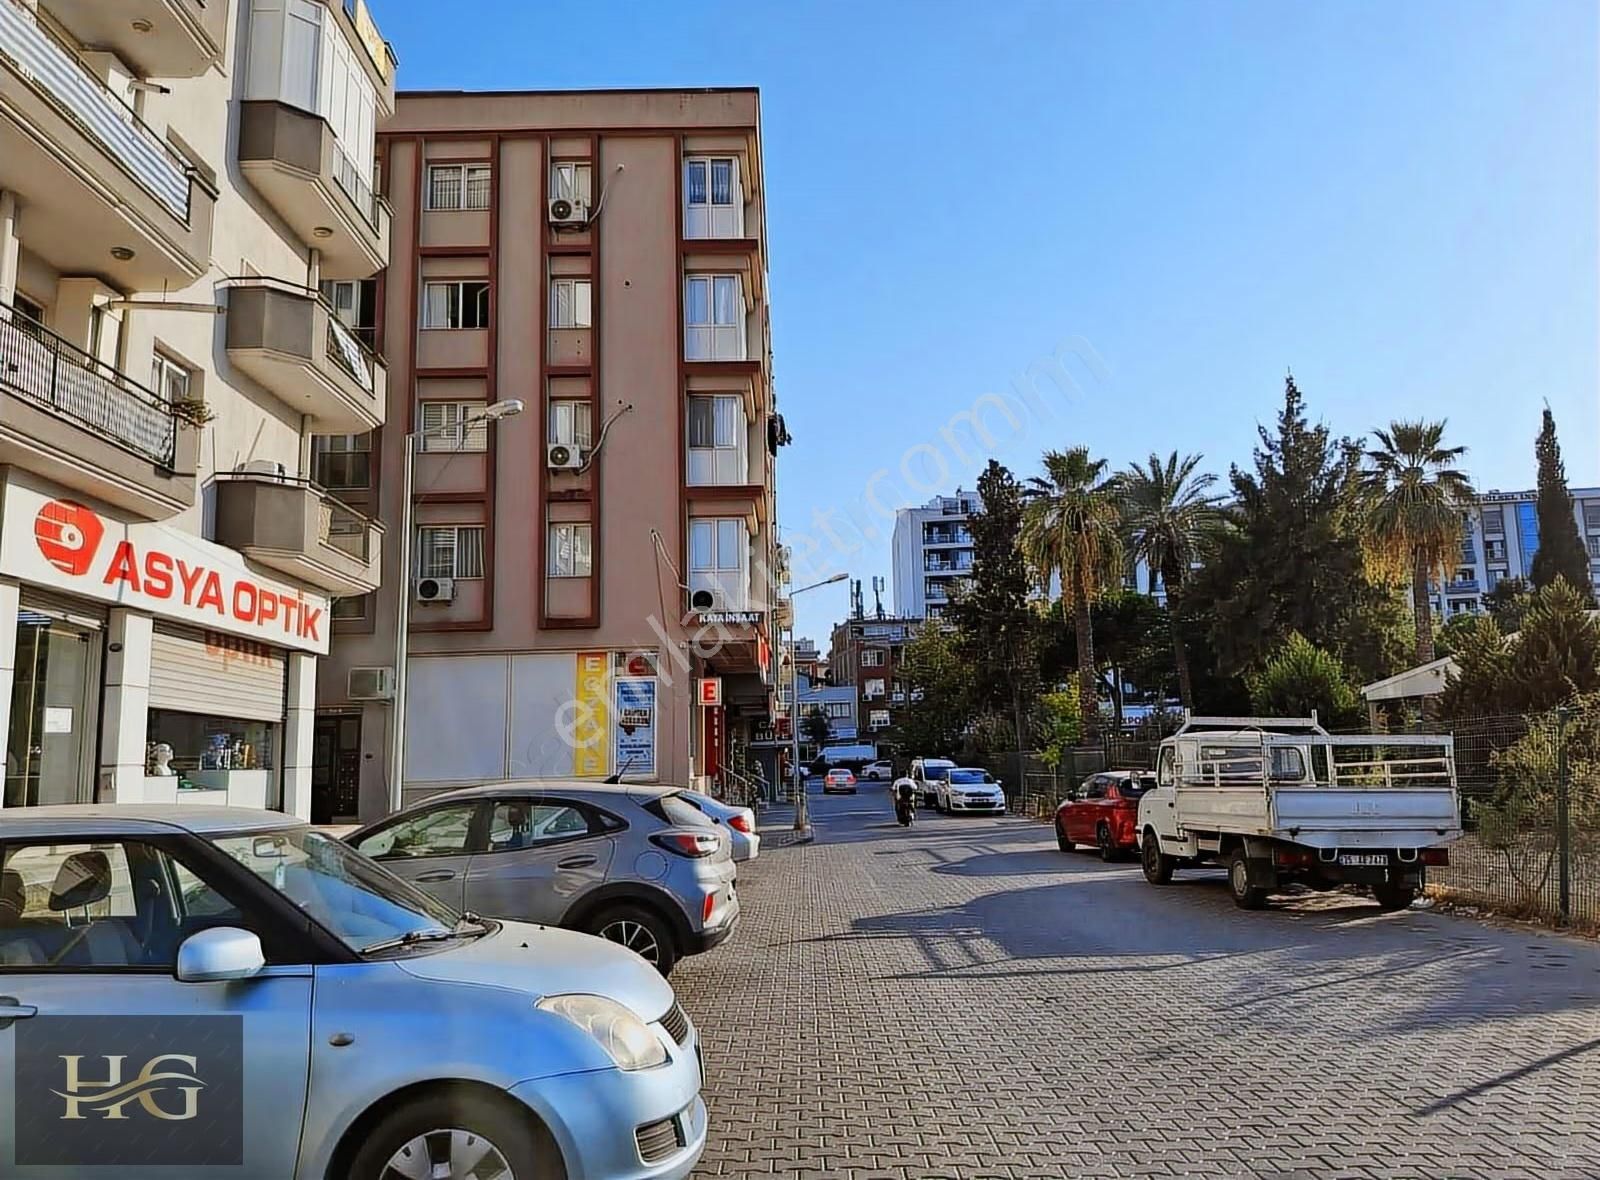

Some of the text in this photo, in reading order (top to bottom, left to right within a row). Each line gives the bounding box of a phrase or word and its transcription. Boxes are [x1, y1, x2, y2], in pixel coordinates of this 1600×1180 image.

[103, 540, 322, 642] ASYA OPTİK
[698, 613, 724, 623] KAYA
[702, 682, 716, 701] E
